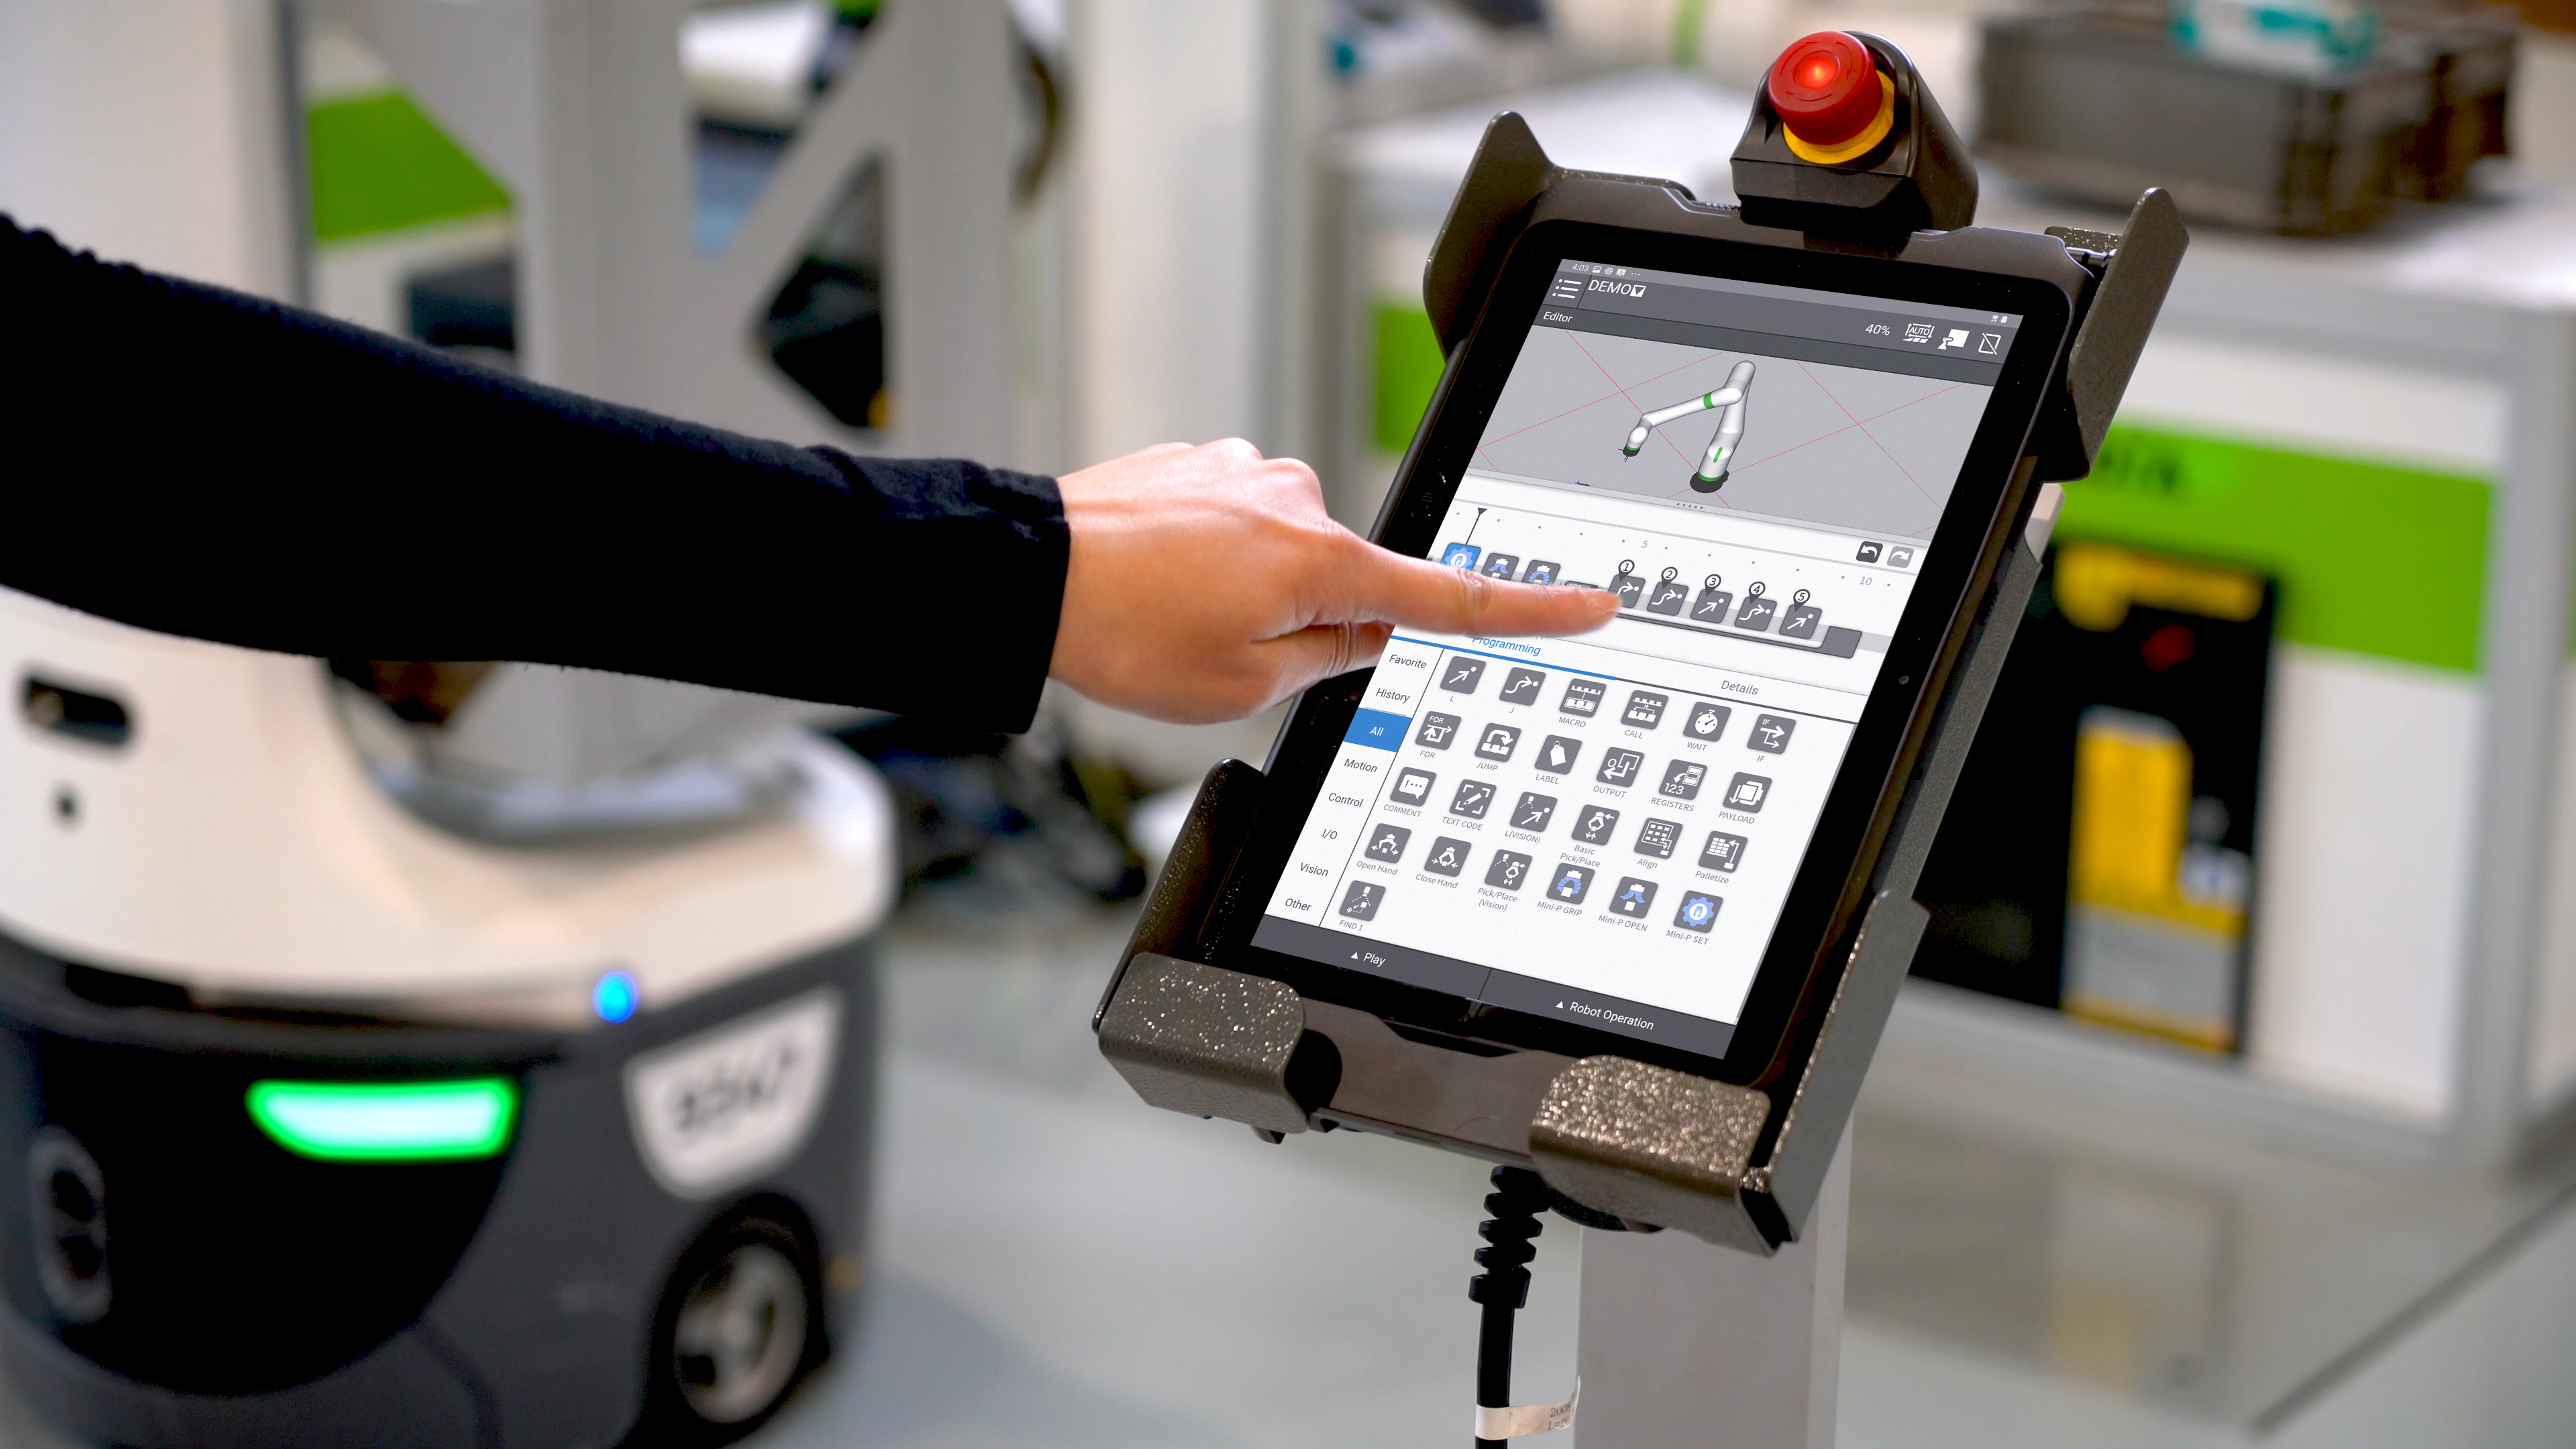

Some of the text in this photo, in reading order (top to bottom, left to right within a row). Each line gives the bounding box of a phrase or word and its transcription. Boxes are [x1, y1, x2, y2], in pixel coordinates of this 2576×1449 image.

[1572, 264, 1589, 272] 4:03
[1588, 280, 1631, 294] DEMO
[1543, 311, 1573, 322] Editor
[1865, 324, 1890, 335] 40%
[1908, 327, 1930, 335] AUTO
[1641, 540, 1648, 548] 5
[1623, 563, 1629, 572] 1
[1665, 570, 1672, 579] 2
[1859, 576, 1872, 586] 10
[1709, 578, 1717, 586] 3
[1753, 585, 1761, 594] 4
[1798, 592, 1806, 602] 5
[1472, 636, 1541, 657] Programming
[1389, 654, 1427, 669] Favorite
[1720, 680, 1758, 695] Details
[1375, 688, 1410, 704] History
[1428, 715, 1444, 724] FOR
[1558, 716, 1587, 728] MACRO
[1369, 727, 1384, 737] All
[1624, 729, 1643, 739] CALL
[1687, 741, 1708, 751] WAIT
[1419, 750, 1436, 759] FOR
[1344, 758, 1377, 773] Motion
[1476, 762, 1499, 771] JUMP
[1536, 773, 1559, 784] LABEL
[1593, 786, 1627, 798] OUTPUT
[1664, 783, 1684, 796] 123
[1328, 793, 1364, 807] Control
[1650, 797, 1695, 812] REGISTERS
[1383, 804, 1422, 818] COMMENT
[1718, 811, 1756, 824] PAYLOAD
[1442, 816, 1483, 831] TEXT CODE
[1322, 828, 1338, 840] I/O
[1505, 830, 1541, 844] L(VISION)
[1574, 845, 1595, 855] Basic
[1560, 853, 1601, 867] Pick/Place
[1637, 859, 1658, 869] Align
[1300, 862, 1329, 877] Vision
[1356, 861, 1398, 875] Open Hand
[1415, 873, 1458, 889] Close Hand
[1695, 871, 1729, 884] Palletize
[1477, 888, 1517, 902] Pick/Place
[1285, 898, 1311, 912] Other
[1479, 899, 1507, 912] (Vision)
[1537, 901, 1582, 916] Mini-P GRIP
[1338, 920, 1357, 930] FIND
[1598, 914, 1648, 932] Mini-P OPEN
[1666, 930, 1709, 945] Mini-P SET
[1363, 953, 1386, 967] Play
[1570, 1002, 1654, 1030] Robot Operation
